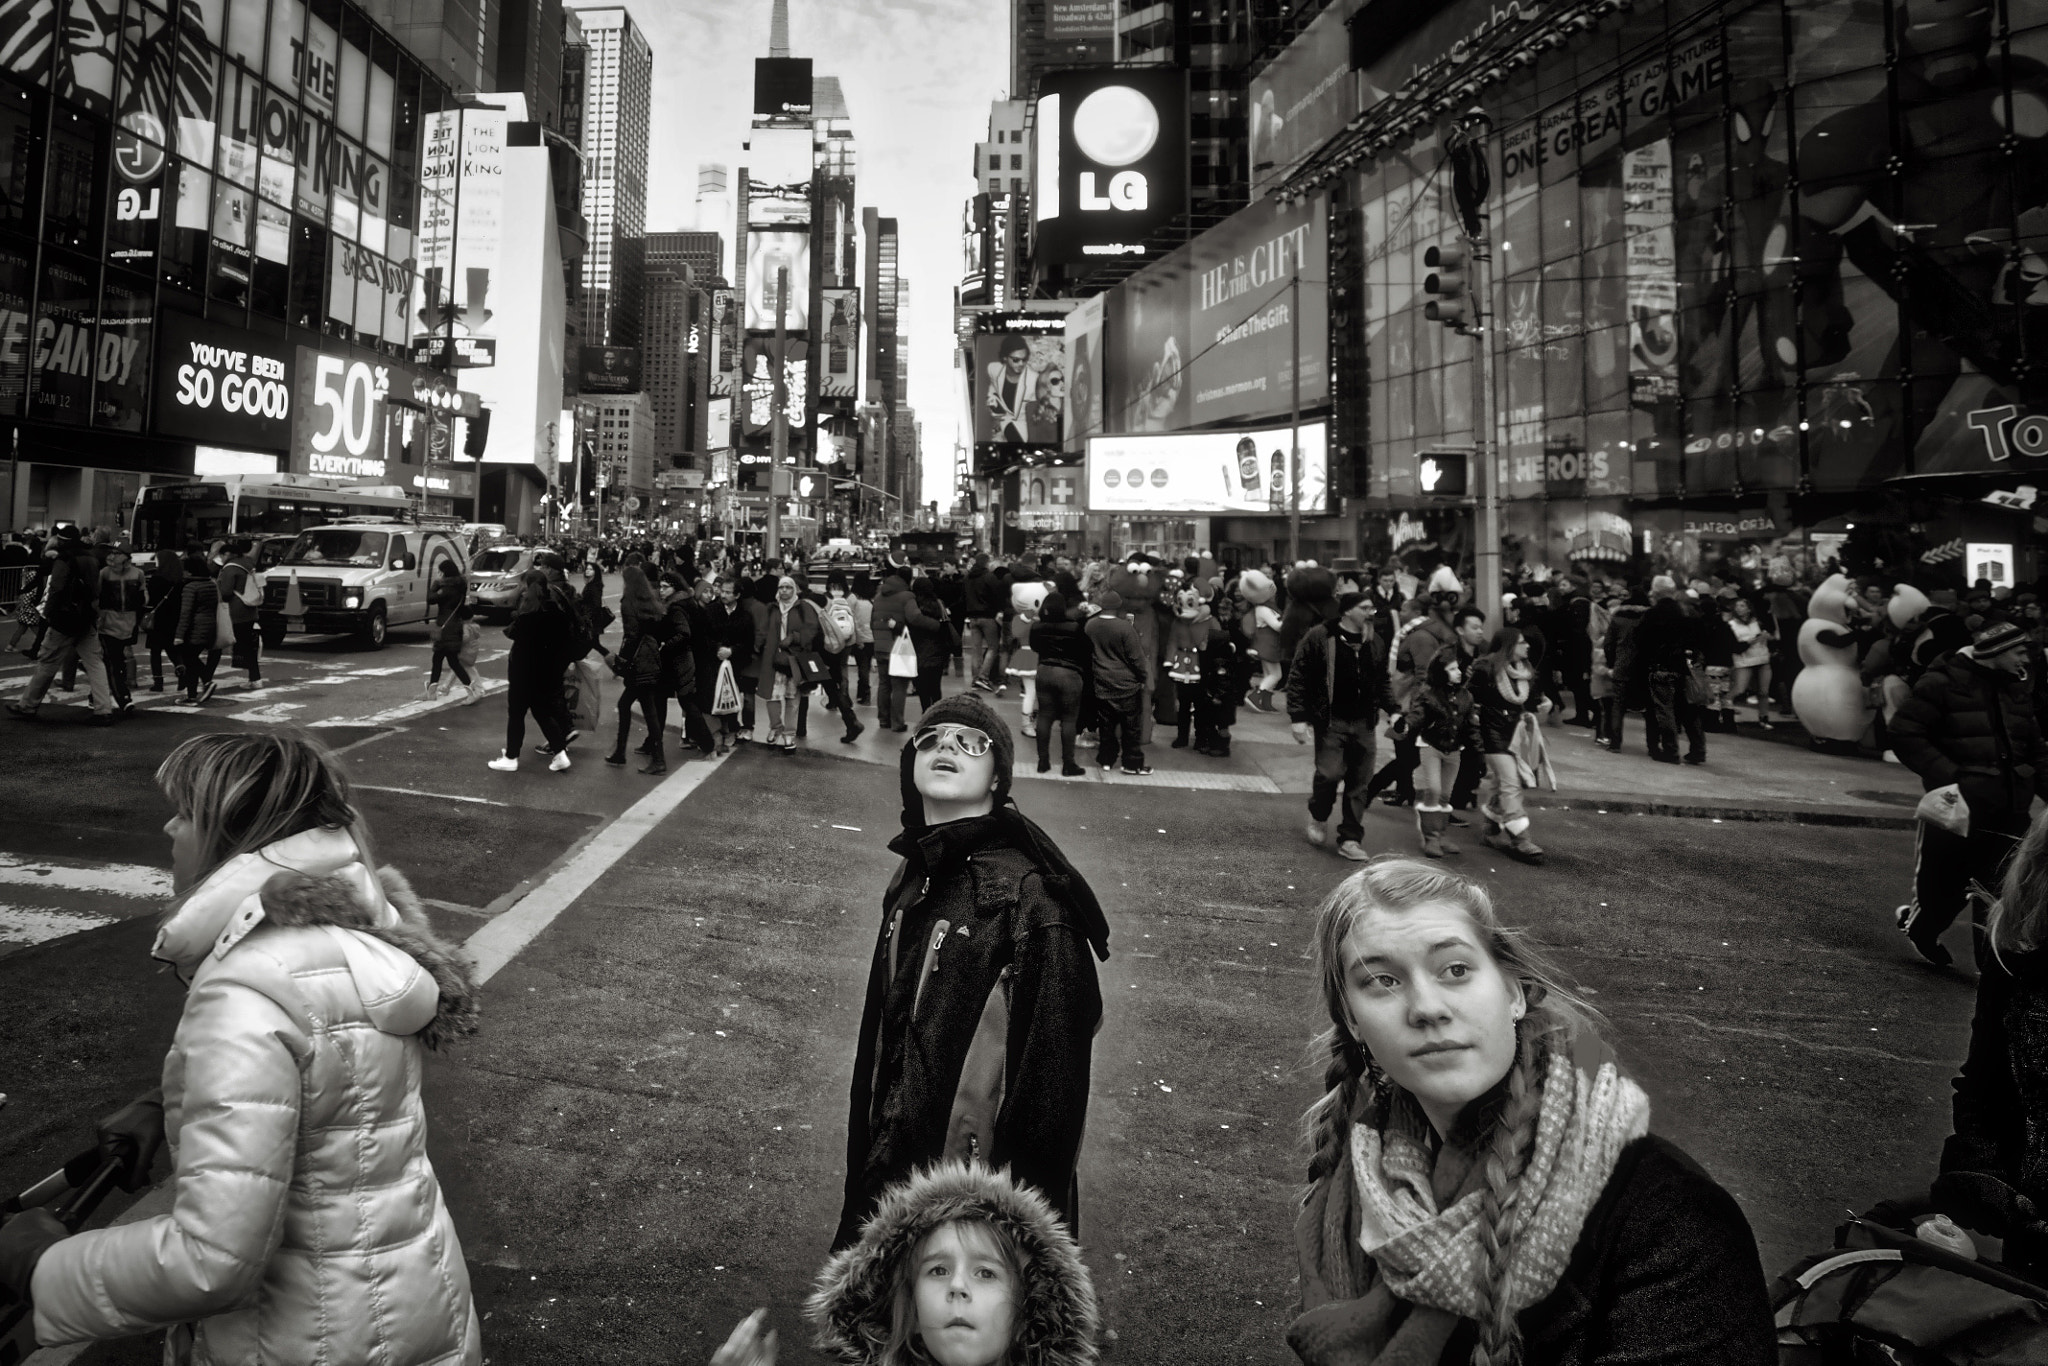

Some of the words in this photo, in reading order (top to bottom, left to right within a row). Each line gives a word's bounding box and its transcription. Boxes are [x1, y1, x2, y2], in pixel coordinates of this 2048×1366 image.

[1053, 13, 1086, 22] Broadway
[291, 36, 334, 102] THE
[232, 53, 310, 168] LION
[1503, 127, 1532, 149] GREAT
[1605, 73, 1641, 101] GREAT
[1504, 137, 1549, 178] ONE
[1554, 96, 1632, 155] GREAT
[1640, 56, 1724, 116] GAME
[468, 141, 499, 156] LION
[473, 128, 494, 137] THE
[313, 108, 380, 208] KING
[464, 160, 502, 177] KING
[1080, 170, 1148, 212] LG
[1234, 255, 1245, 276] IS
[1250, 222, 1310, 288] GIFT
[48, 266, 87, 286] ORIGINAL
[1201, 262, 1229, 311] HE
[1229, 272, 1250, 299] THE
[40, 301, 83, 320] JUSTICE
[34, 317, 139, 386] CANDY
[190, 341, 247, 373] YOU'VE
[252, 355, 285, 381] BEEN
[39, 392, 56, 406] JAN
[60, 394, 71, 409] 12
[176, 363, 215, 409] SO
[220, 373, 289, 420] GOOD
[309, 453, 386, 478] EVERYTHING
[1515, 451, 1609, 482] HEROES
